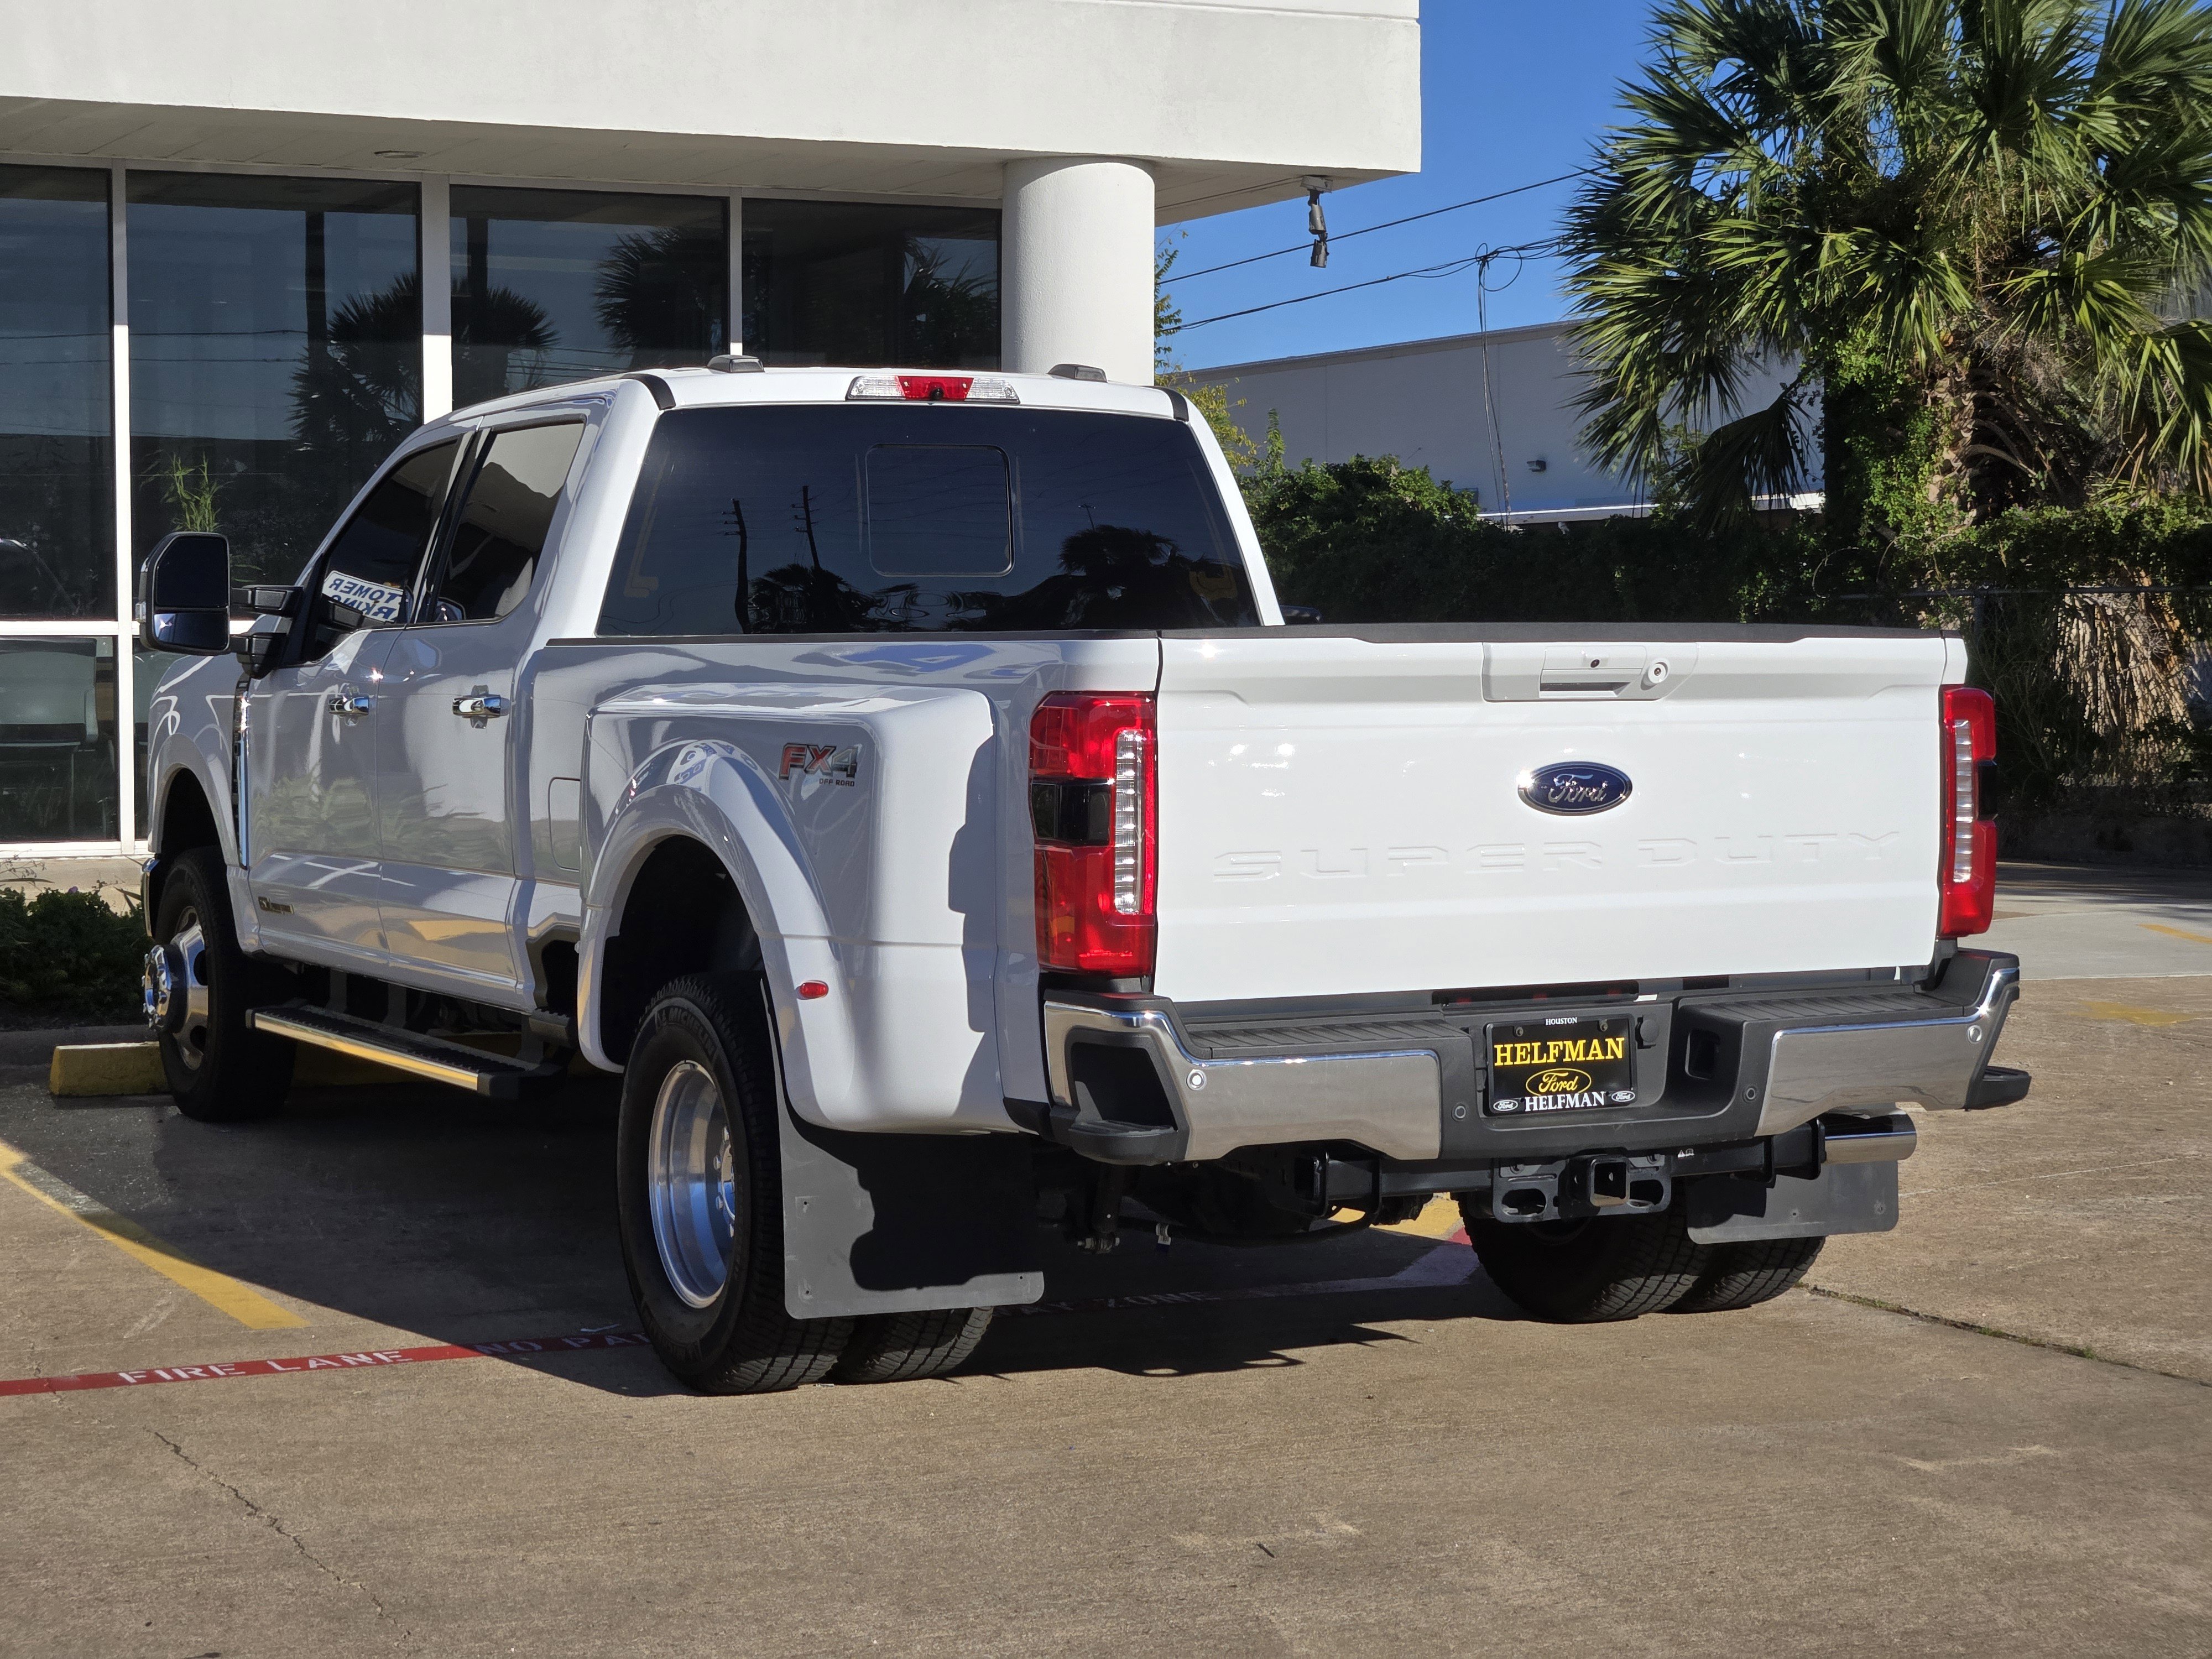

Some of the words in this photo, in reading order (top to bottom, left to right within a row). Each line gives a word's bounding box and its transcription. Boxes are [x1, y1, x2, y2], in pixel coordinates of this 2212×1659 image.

[779, 743, 858, 780] FX4
[1548, 773, 1607, 803] Ford
[1212, 840, 1603, 883] SUPER
[1637, 831, 1900, 868] DUTY
[669, 1006, 716, 1055] MICHELIN
[1545, 1016, 1577, 1025] HOUSTON
[1494, 1037, 1625, 1066] HELFMAN
[1538, 1071, 1579, 1093] Ford
[1524, 1091, 1606, 1112] HELFMAN
[118, 1363, 246, 1383] FIRE
[267, 1350, 413, 1371] LANE
[474, 1342, 543, 1354] NO
